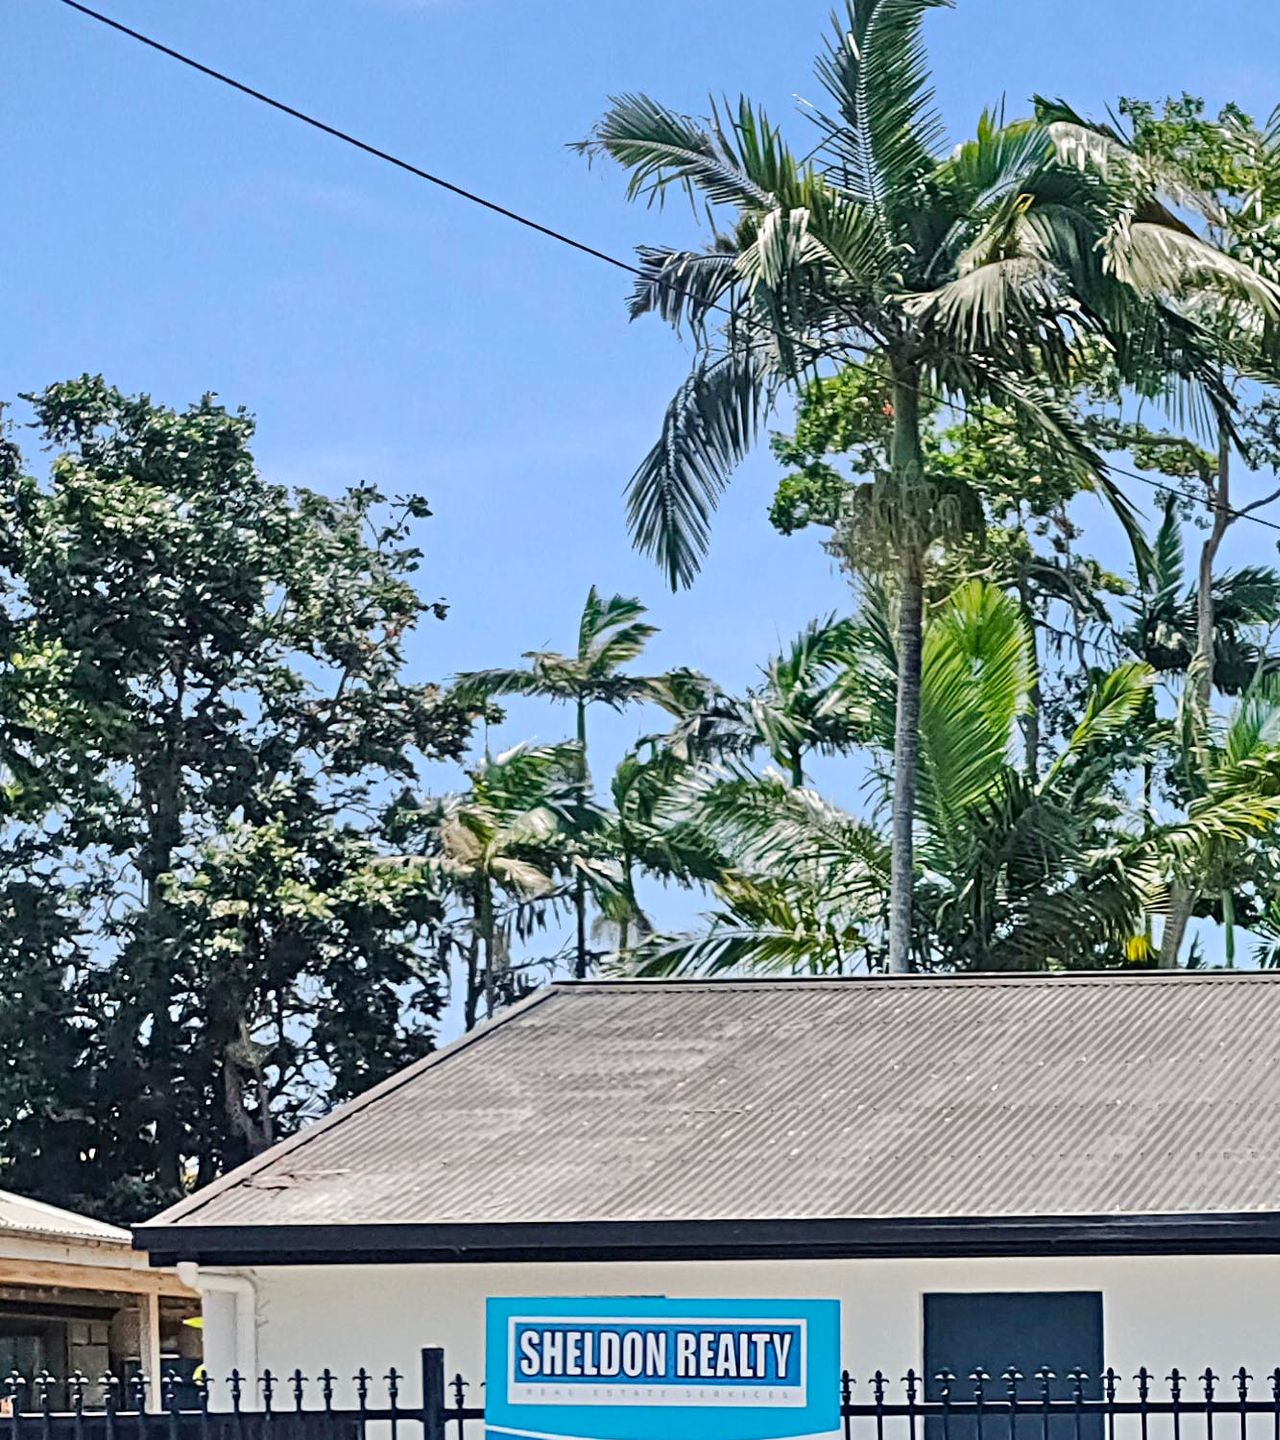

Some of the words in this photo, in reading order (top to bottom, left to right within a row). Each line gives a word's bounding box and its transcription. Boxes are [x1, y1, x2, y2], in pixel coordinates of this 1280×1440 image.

[519, 1330, 666, 1377] SHELDON
[676, 1332, 792, 1378] REALTY
[525, 1388, 574, 1397] REAL
[592, 1388, 667, 1398] ESTATE
[686, 1390, 790, 1400] SERVICES
